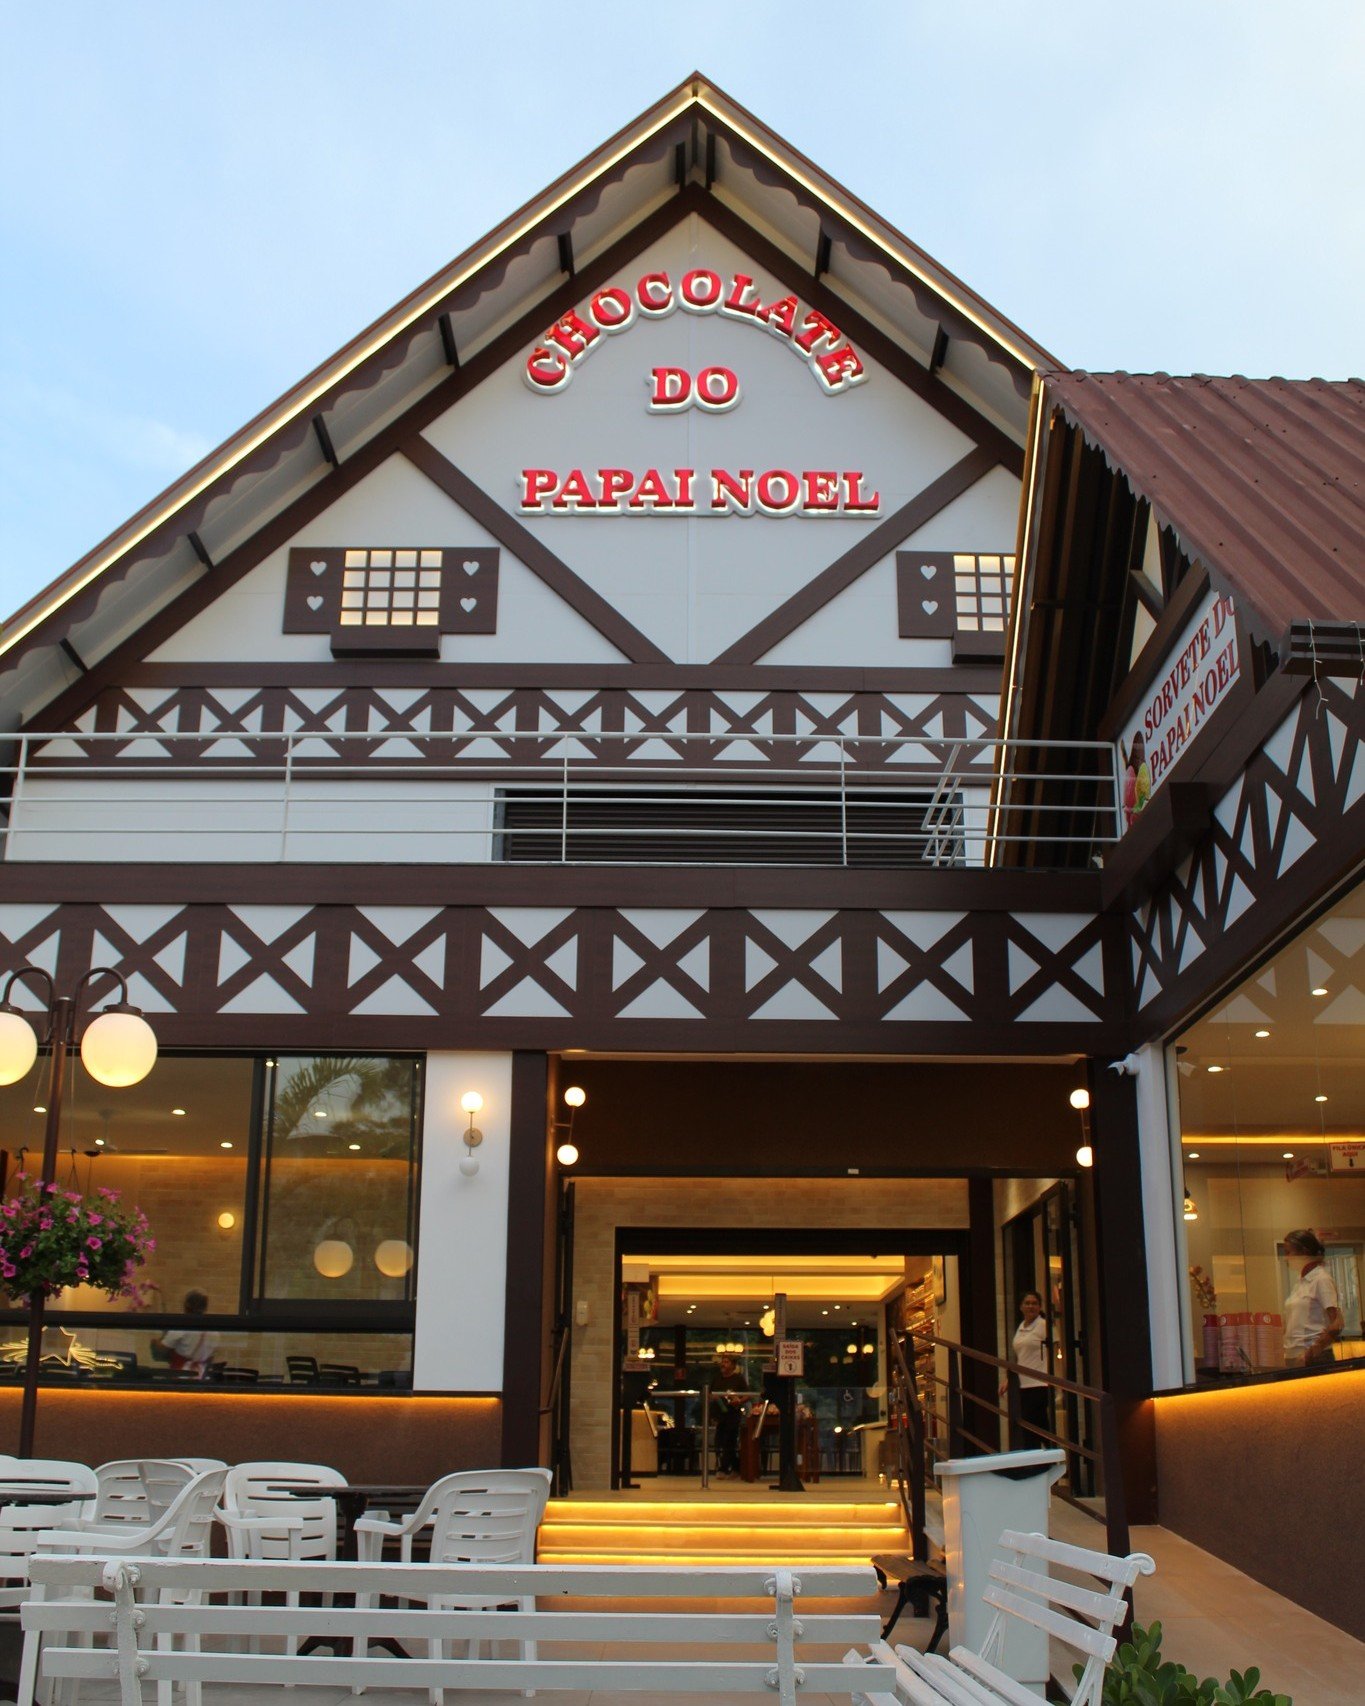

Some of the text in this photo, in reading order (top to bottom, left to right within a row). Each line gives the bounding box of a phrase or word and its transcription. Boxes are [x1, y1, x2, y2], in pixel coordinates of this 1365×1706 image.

[524, 268, 868, 394] CHOCOLATE
[650, 366, 740, 409] DO
[520, 468, 881, 512] PAPAI NOEL
[1144, 618, 1211, 743] SORVETE
[1150, 639, 1240, 786] PAPAI NOEL
